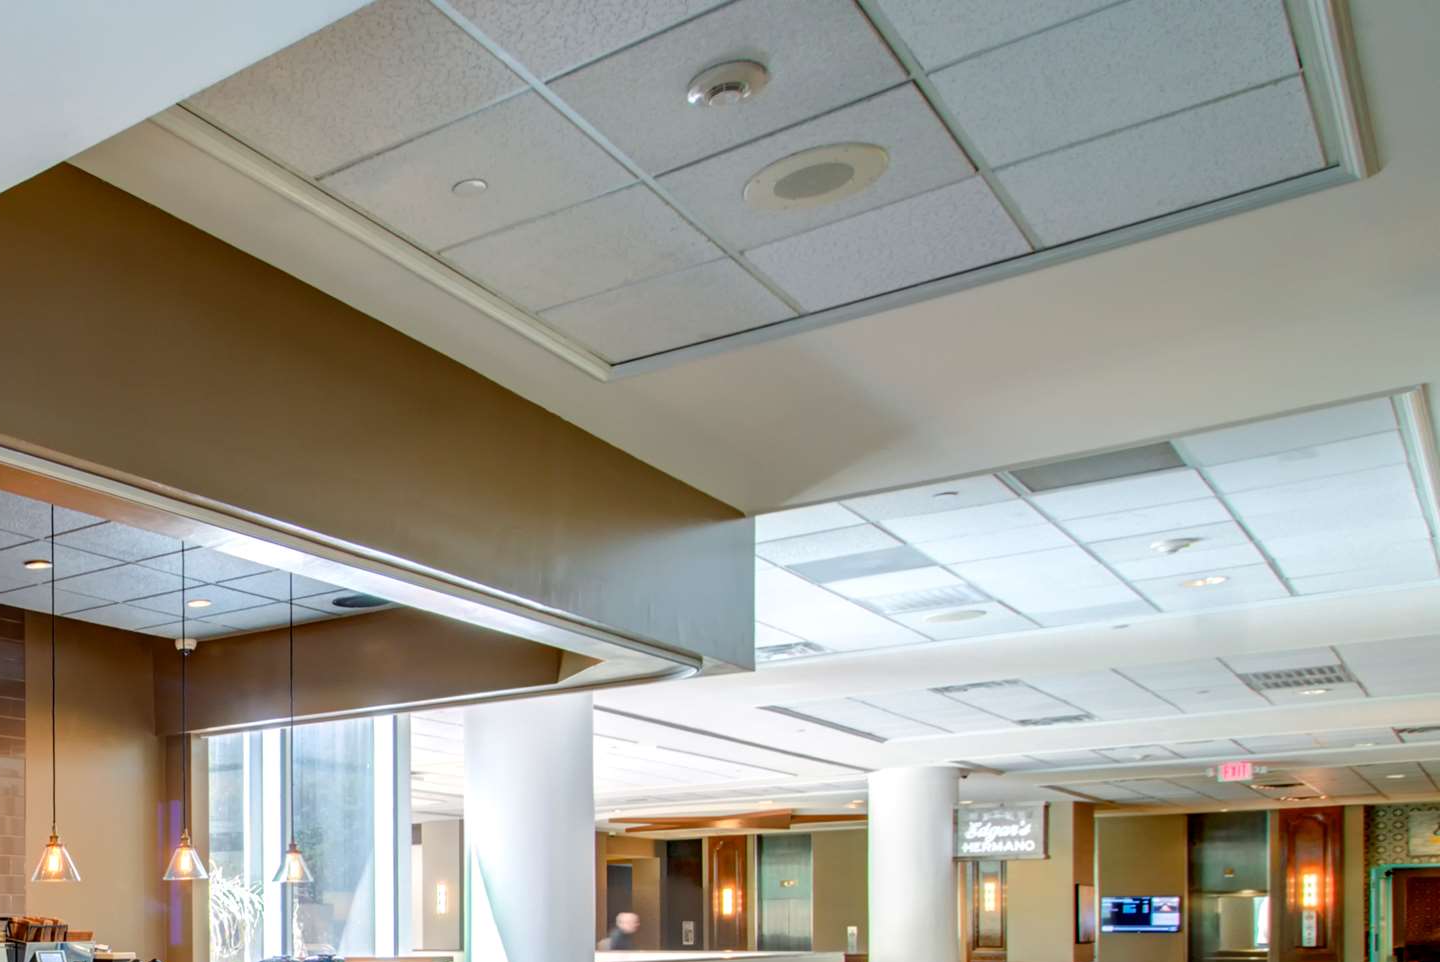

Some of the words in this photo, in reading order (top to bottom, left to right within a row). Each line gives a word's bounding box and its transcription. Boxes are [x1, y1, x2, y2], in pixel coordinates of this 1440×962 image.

[1223, 763, 1250, 779] EXIT
[964, 819, 1032, 842] Edgar's
[961, 840, 1036, 854] HERMANO
